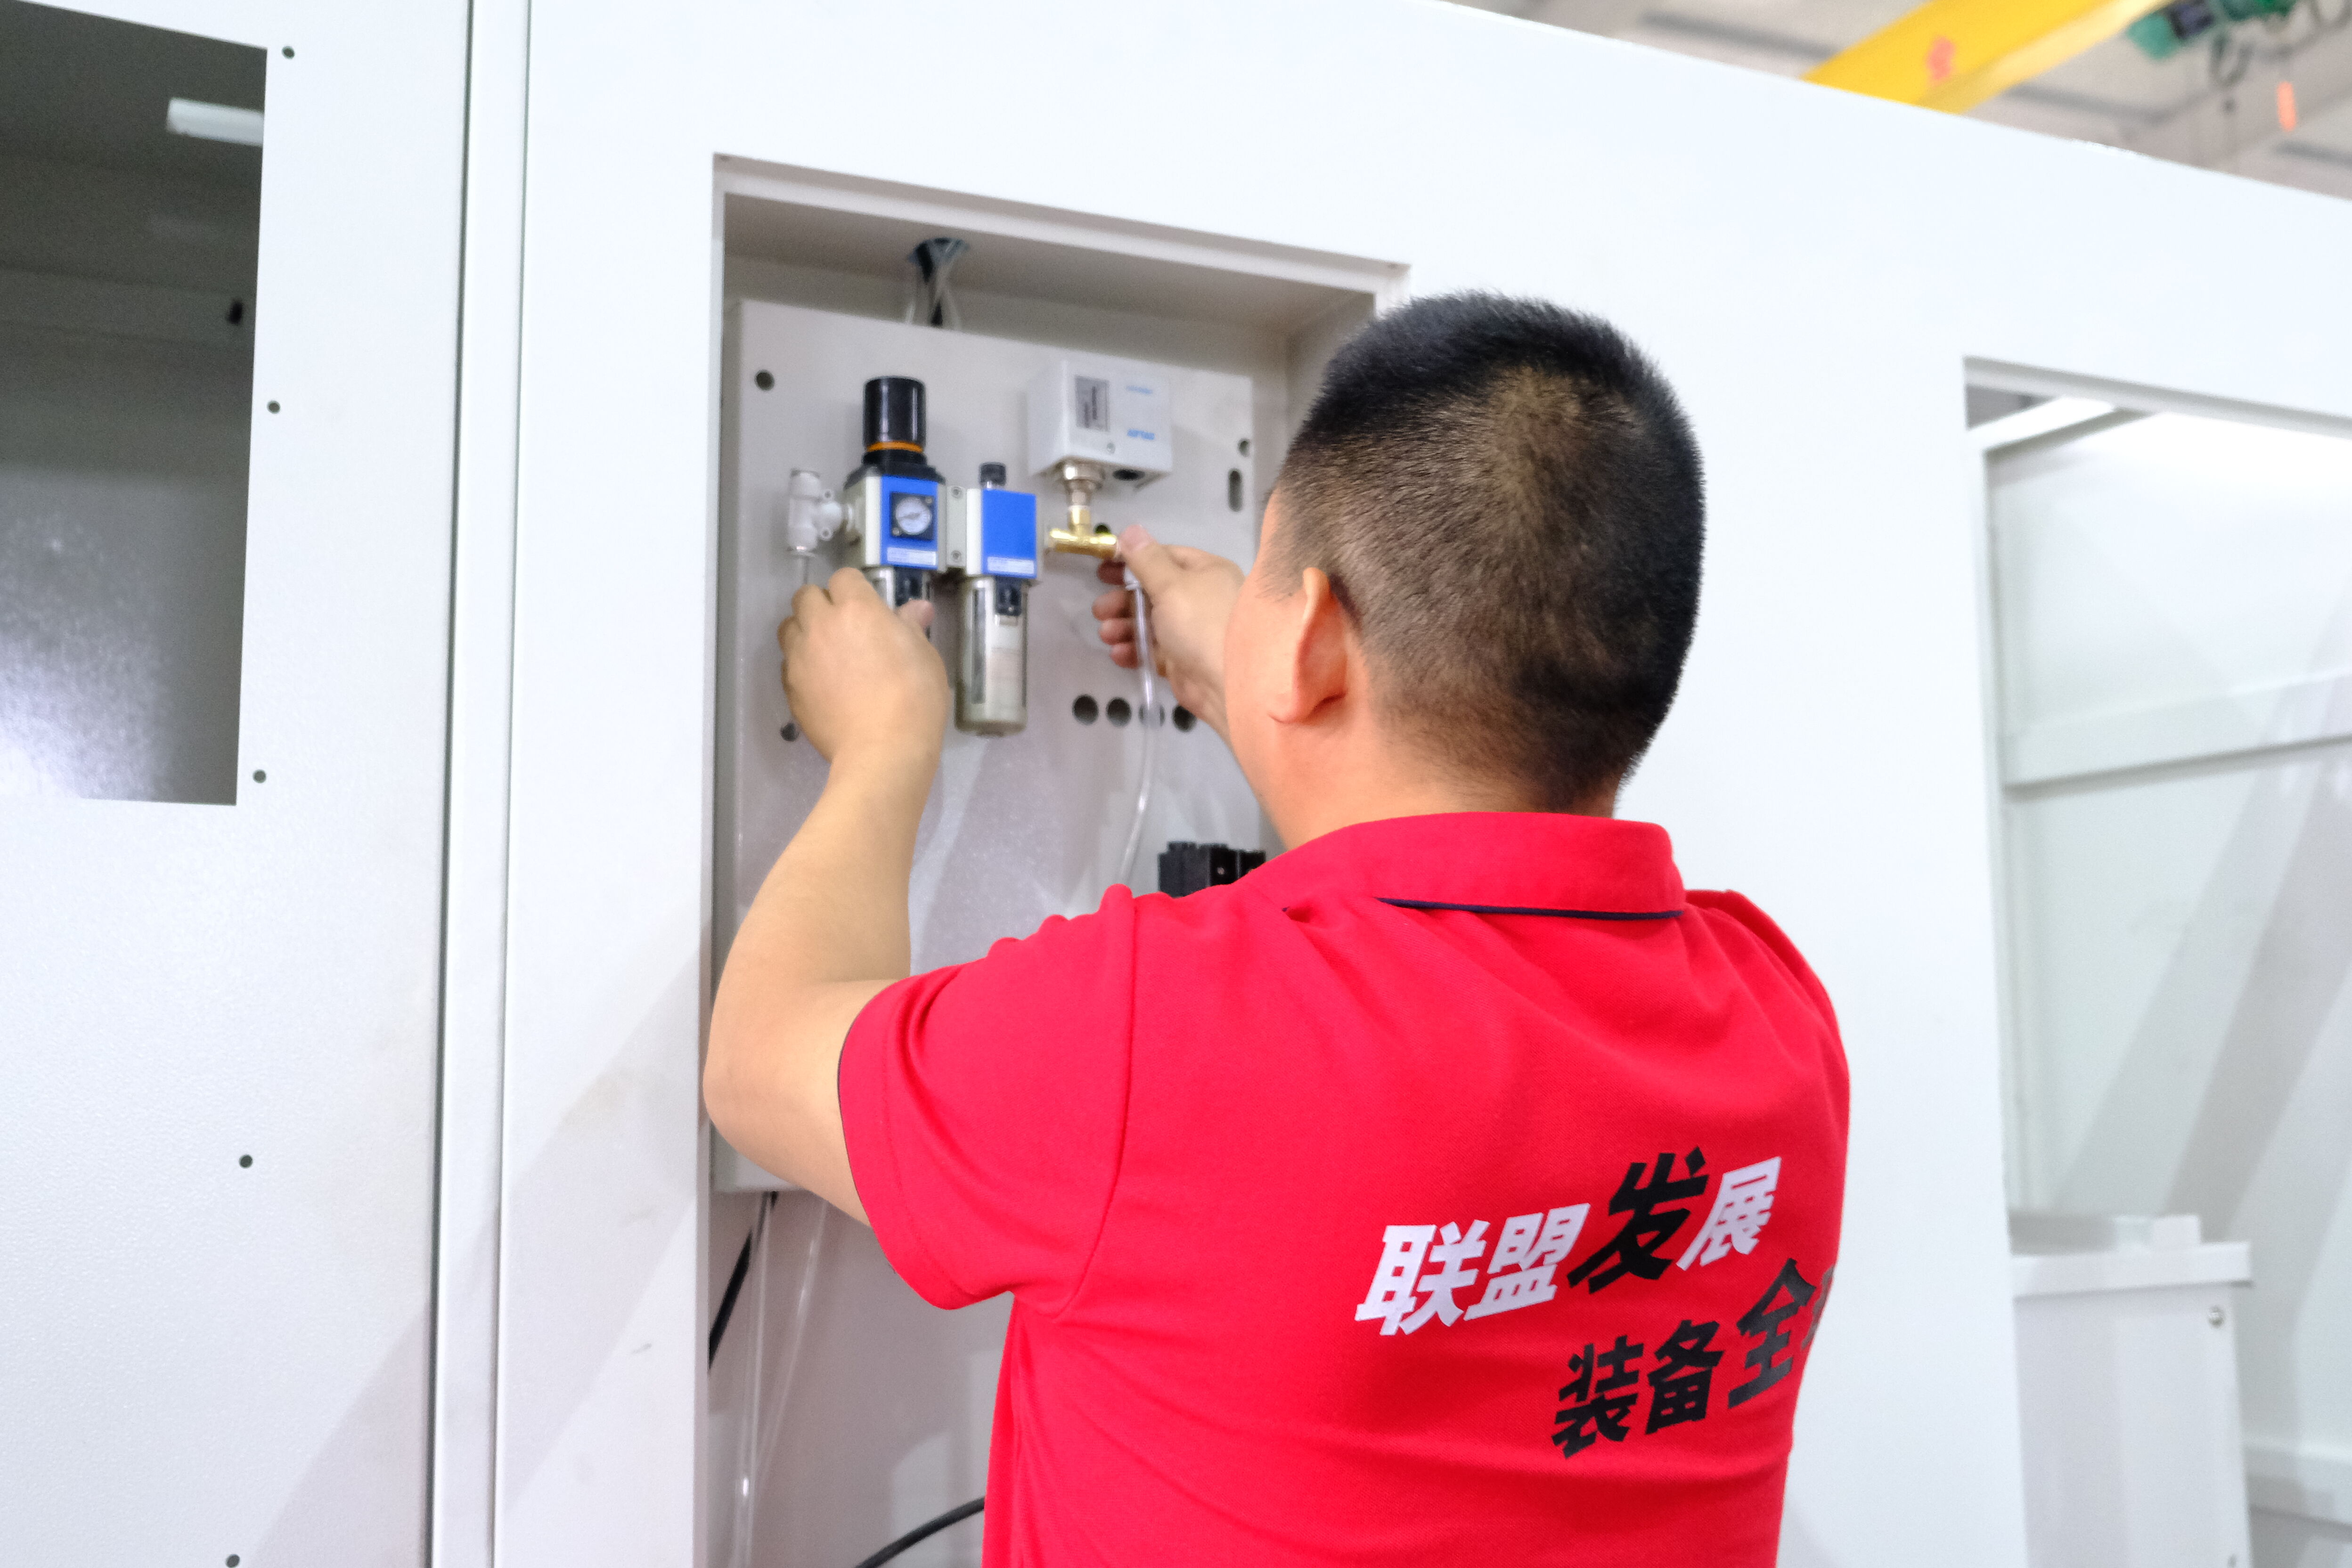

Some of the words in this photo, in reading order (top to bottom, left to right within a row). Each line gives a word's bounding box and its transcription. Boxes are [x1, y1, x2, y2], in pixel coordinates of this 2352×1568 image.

[1355, 1147, 1781, 1335] 联盟发展
[1552, 1258, 1834, 1458] 装备全
